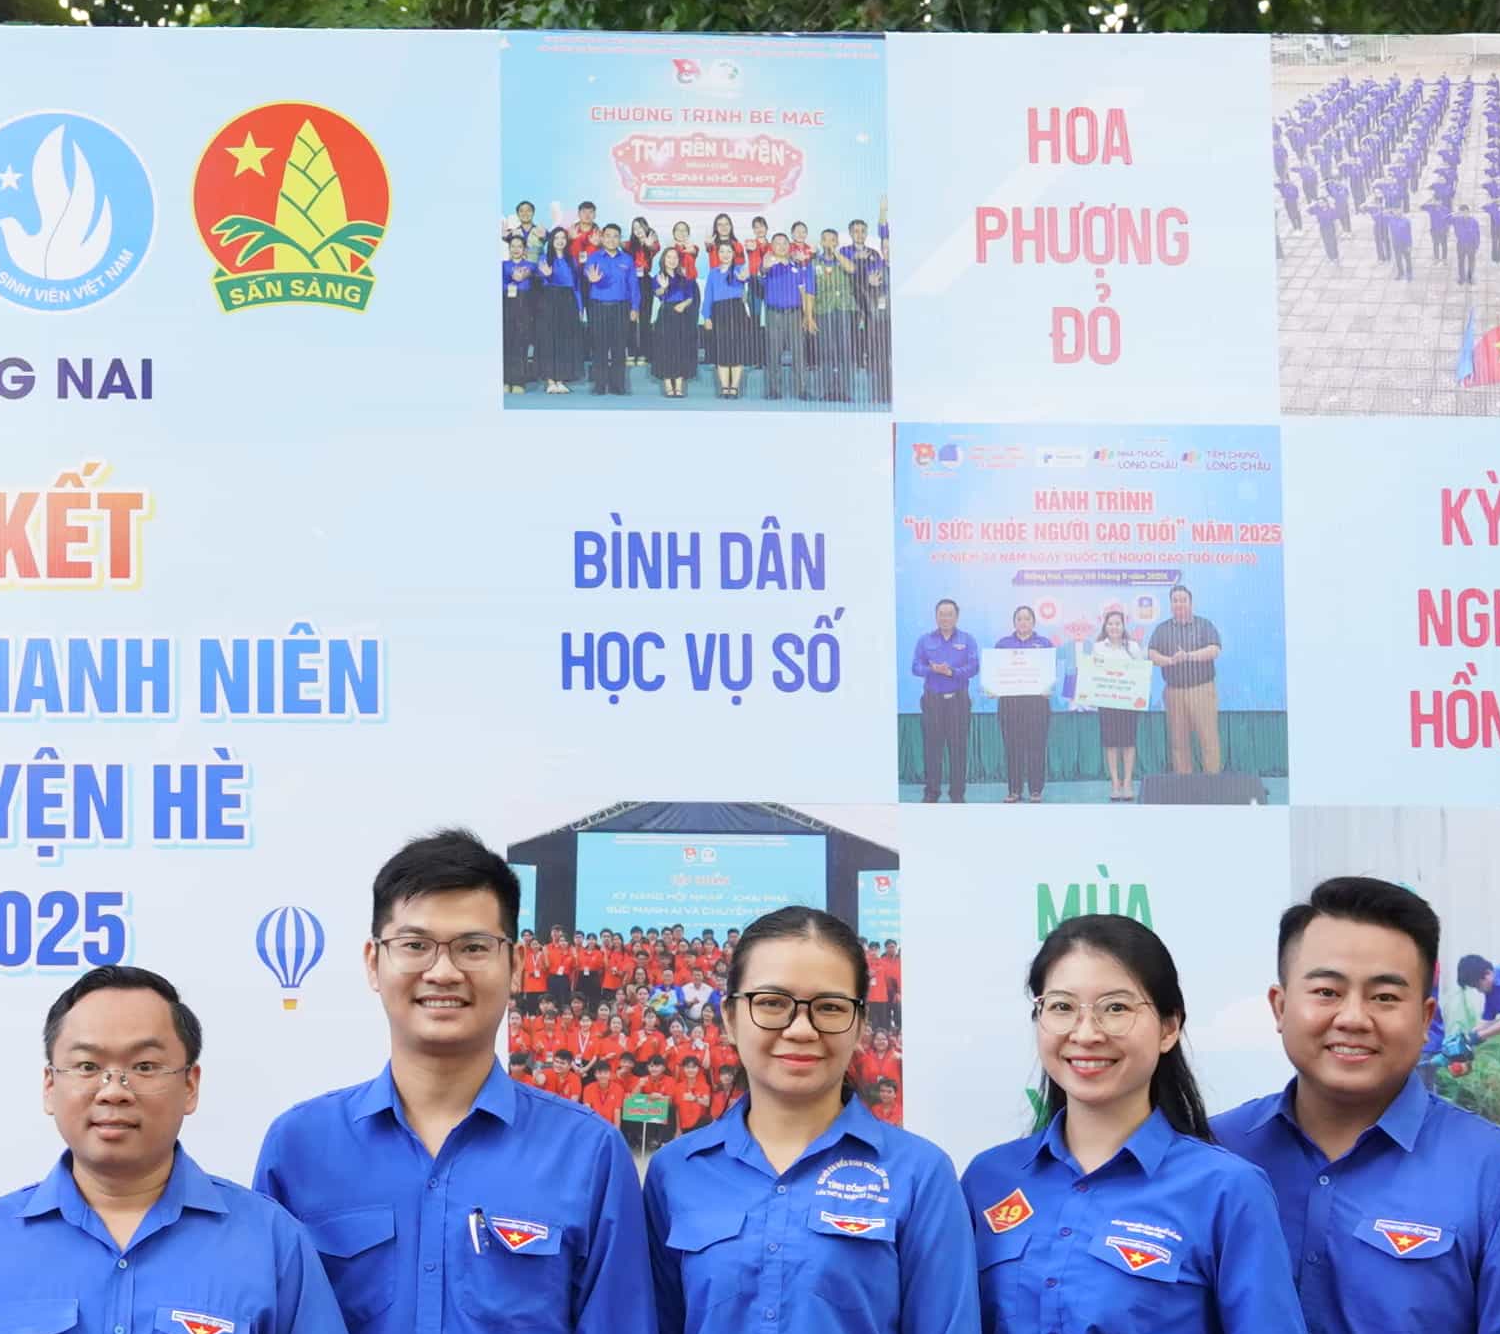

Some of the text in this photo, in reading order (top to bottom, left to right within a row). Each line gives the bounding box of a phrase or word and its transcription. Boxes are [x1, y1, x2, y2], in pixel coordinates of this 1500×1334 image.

[1028, 107, 1132, 165] HOA
[34, 287, 71, 303] VIÊN
[73, 275, 104, 300] VIỆT
[106, 248, 134, 279] NAM
[976, 202, 1188, 278] PHƯỢNG
[230, 276, 361, 305] SẴN SÀNG
[1049, 283, 1120, 365] ĐỎ
[58, 358, 152, 399] NAI
[575, 513, 825, 590] BÌNH DÂN
[200, 623, 378, 714] NIÊN
[562, 607, 844, 705] HỌC VỤ SỐ
[154, 748, 244, 839] HÈ
[1036, 864, 1154, 941] MÙA
